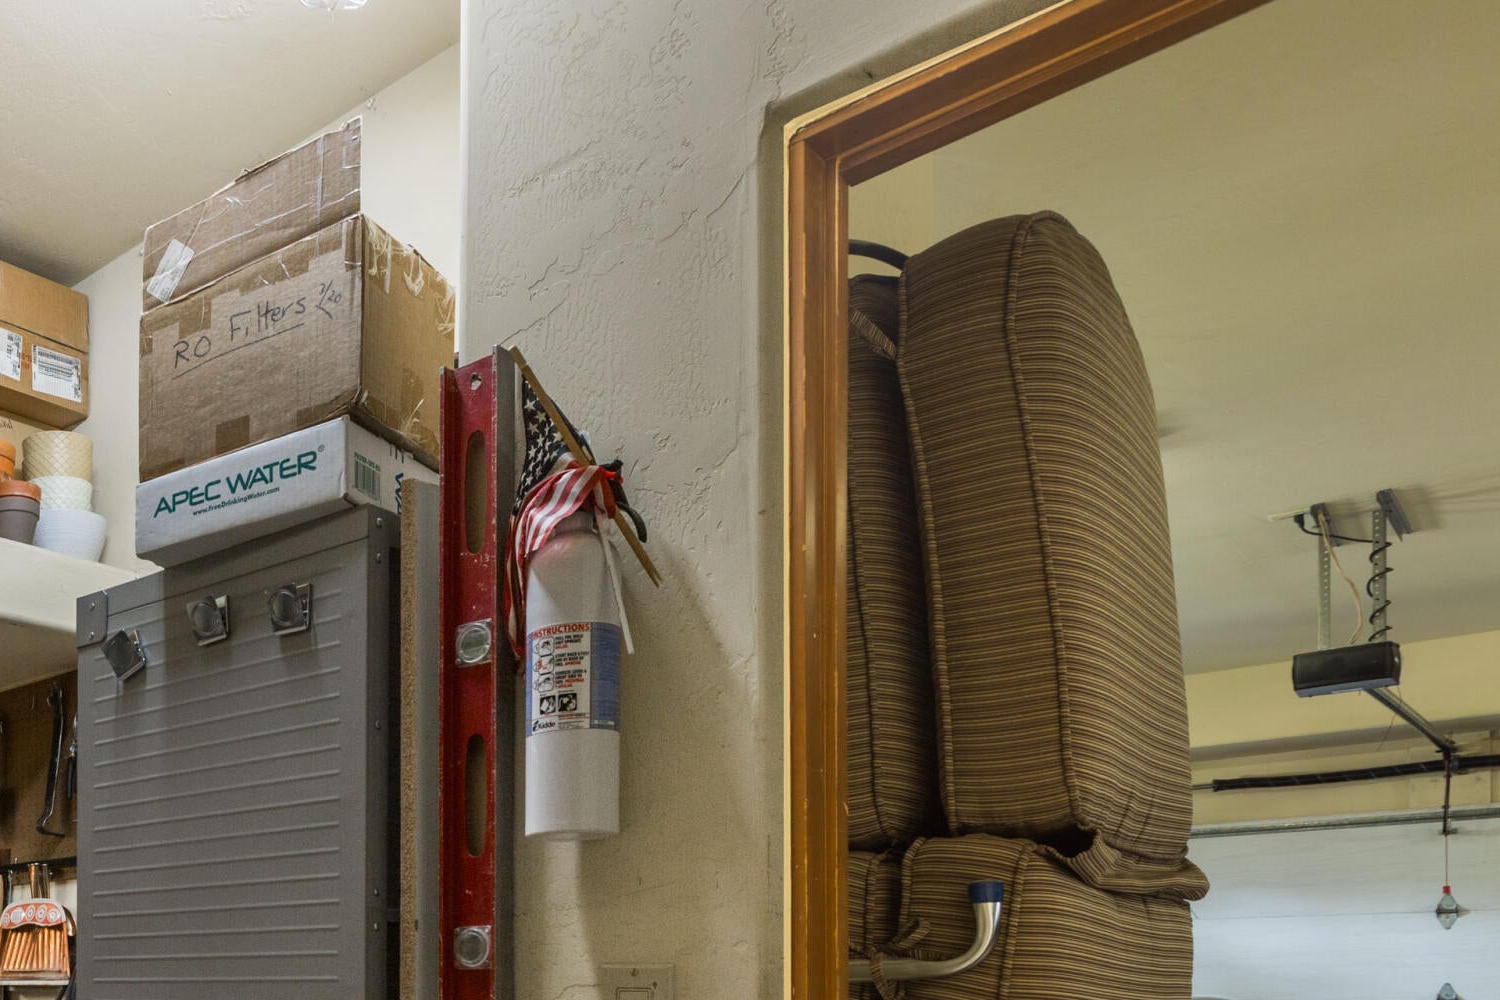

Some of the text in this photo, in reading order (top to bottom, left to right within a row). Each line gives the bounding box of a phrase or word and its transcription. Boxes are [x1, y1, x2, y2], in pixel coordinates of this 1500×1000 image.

[173, 336, 211, 369] RO
[230, 296, 306, 341] Filters
[154, 450, 318, 518] APEC WATER
